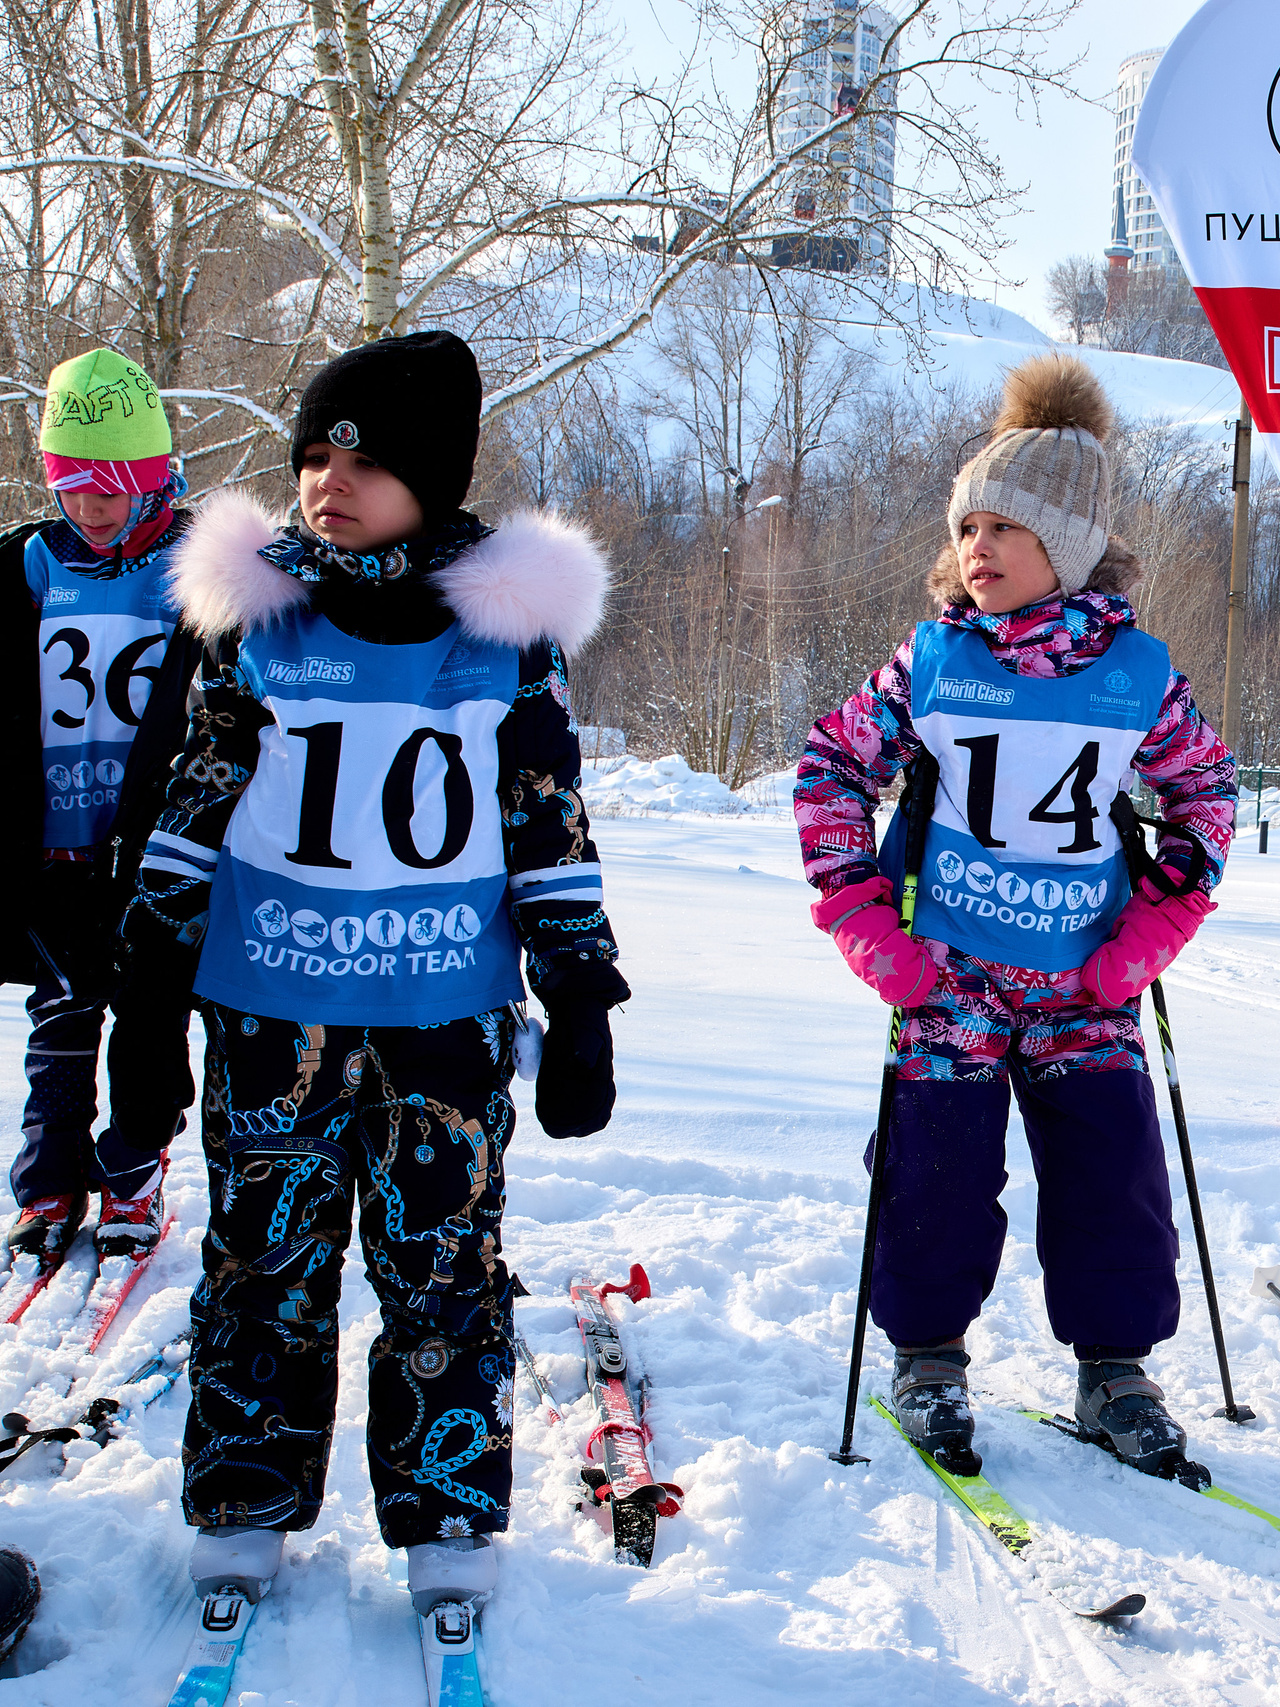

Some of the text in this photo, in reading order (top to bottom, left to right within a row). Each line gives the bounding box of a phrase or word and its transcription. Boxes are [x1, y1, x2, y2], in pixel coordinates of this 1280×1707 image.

[49, 588, 78, 603] Class
[42, 627, 168, 729] 36
[307, 659, 352, 681] Class
[939, 680, 1012, 703] World Class
[1089, 693, 1141, 707] Пушкинский
[285, 721, 475, 870] 10
[953, 733, 1103, 854] 14
[930, 883, 1054, 933] OUTDOOR
[244, 939, 397, 977] OUTDOOR
